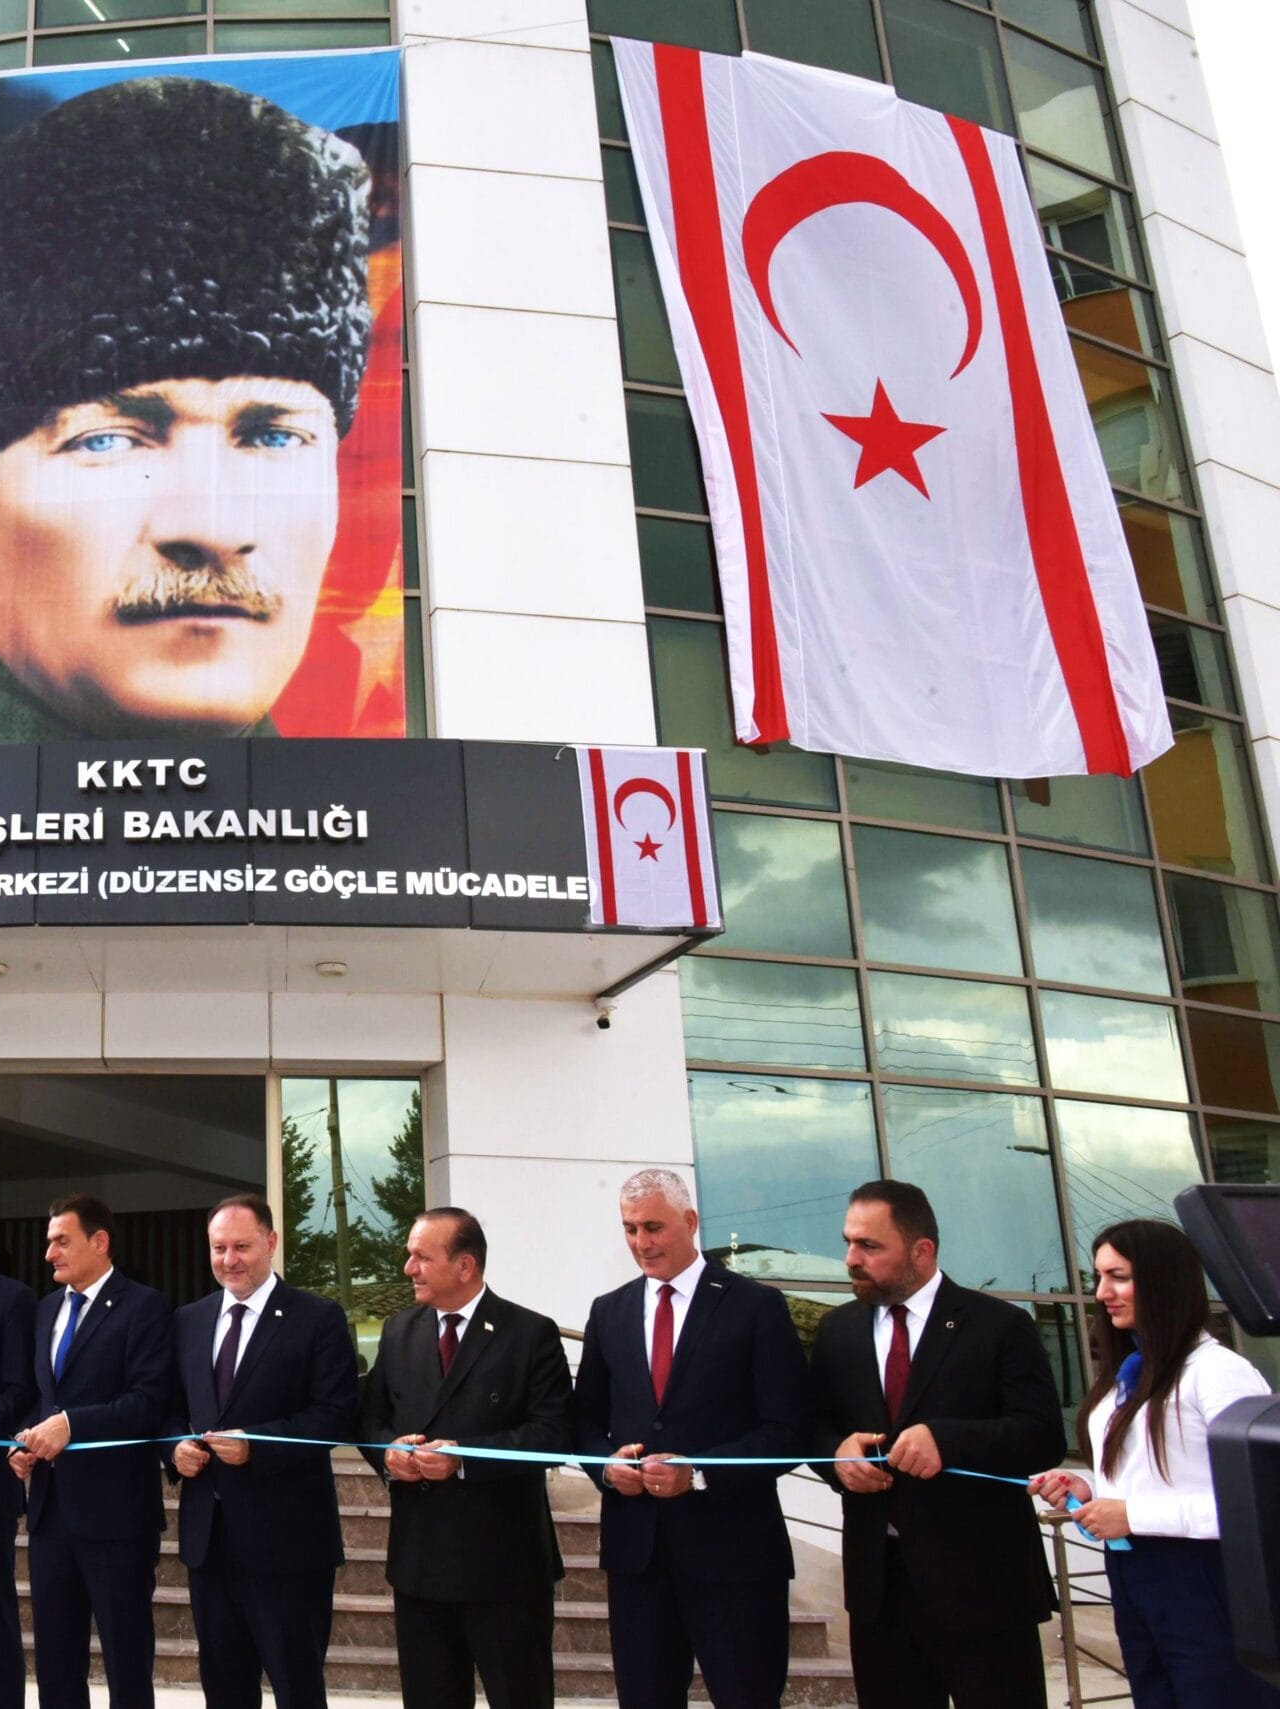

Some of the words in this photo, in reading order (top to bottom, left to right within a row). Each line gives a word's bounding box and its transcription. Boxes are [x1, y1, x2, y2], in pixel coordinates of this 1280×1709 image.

[76, 758, 208, 790] KKTC
[123, 804, 369, 842] BAKANLIĞI
[98, 864, 278, 900] (DÜZENSİZ
[284, 865, 398, 900] GÖÇLE
